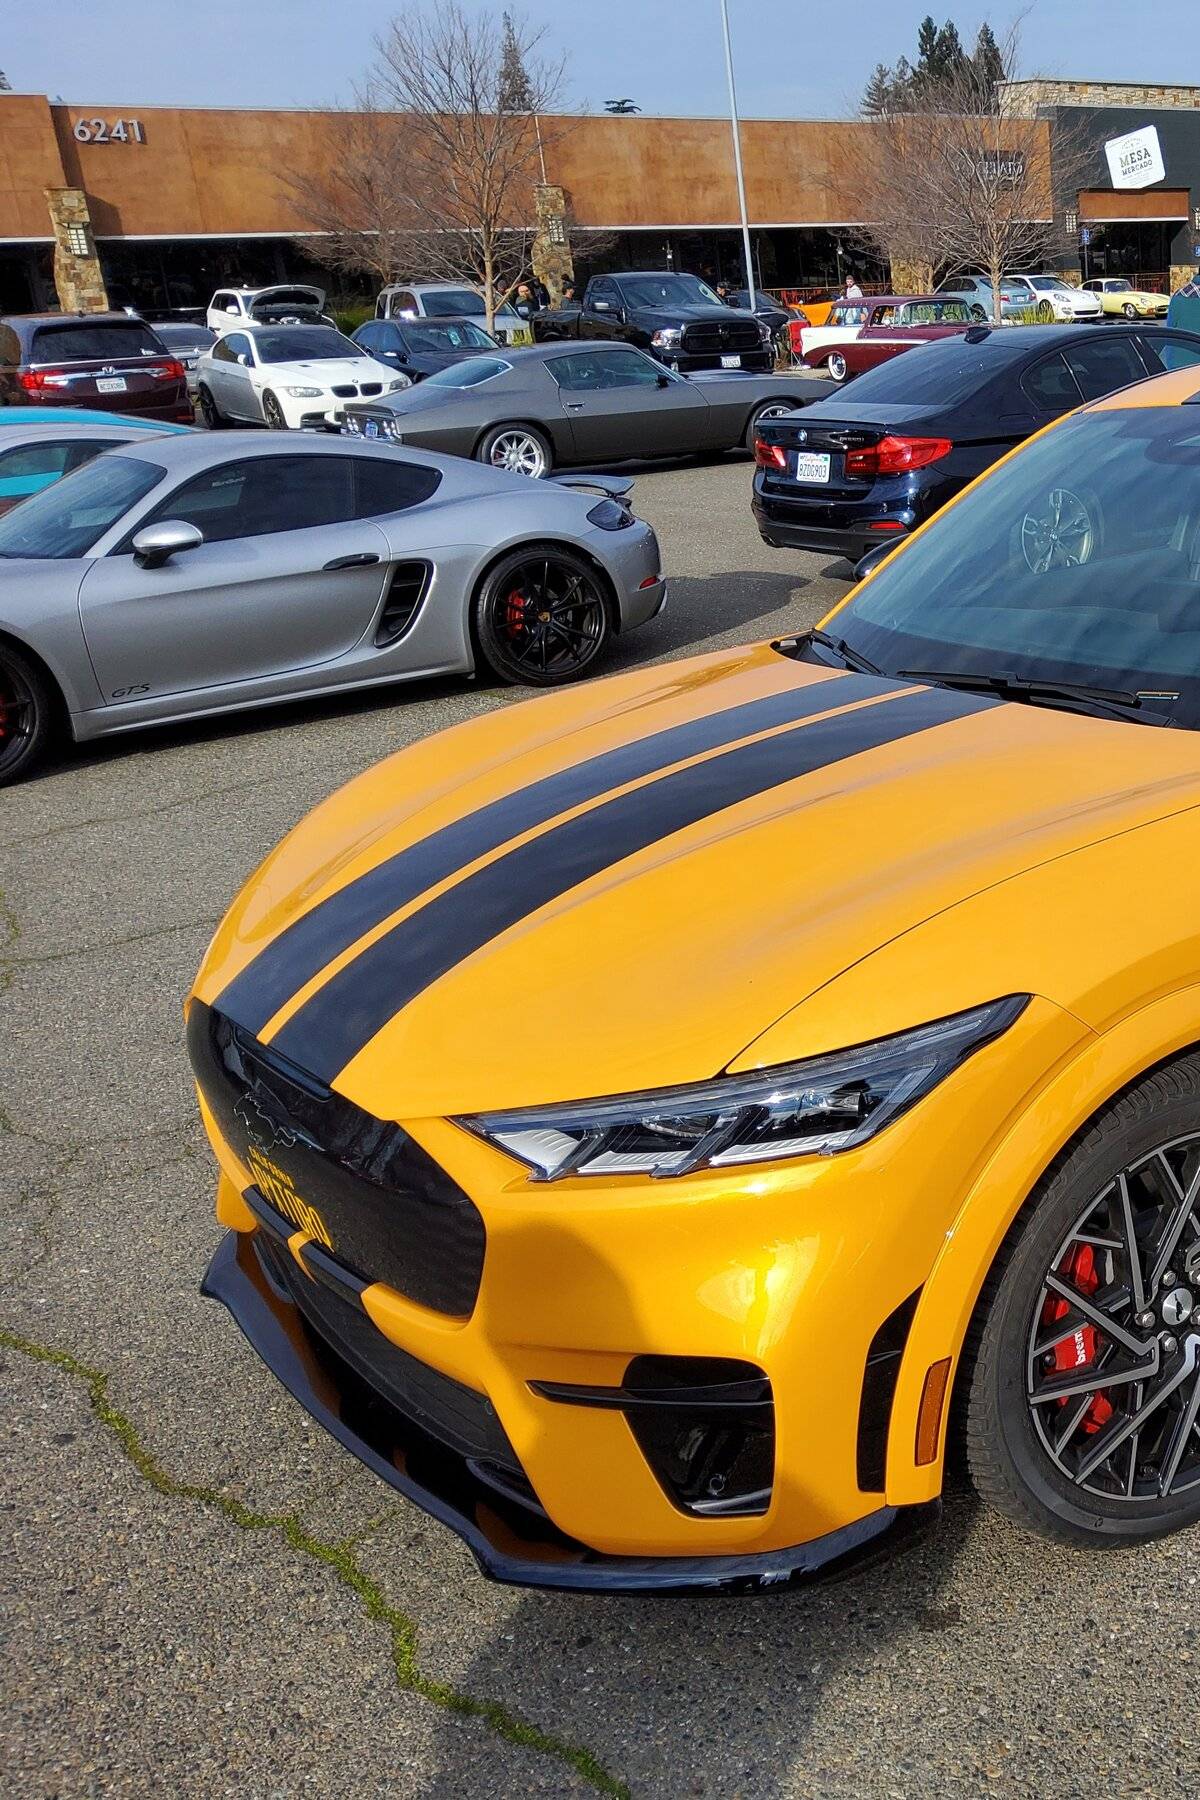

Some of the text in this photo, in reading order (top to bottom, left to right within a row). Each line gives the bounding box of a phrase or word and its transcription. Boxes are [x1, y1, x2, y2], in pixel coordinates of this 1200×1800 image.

[74, 118, 142, 142] 6241
[1119, 147, 1152, 168] MESA
[1121, 159, 1153, 176] MERCADO
[111, 683, 150, 698] GTS
